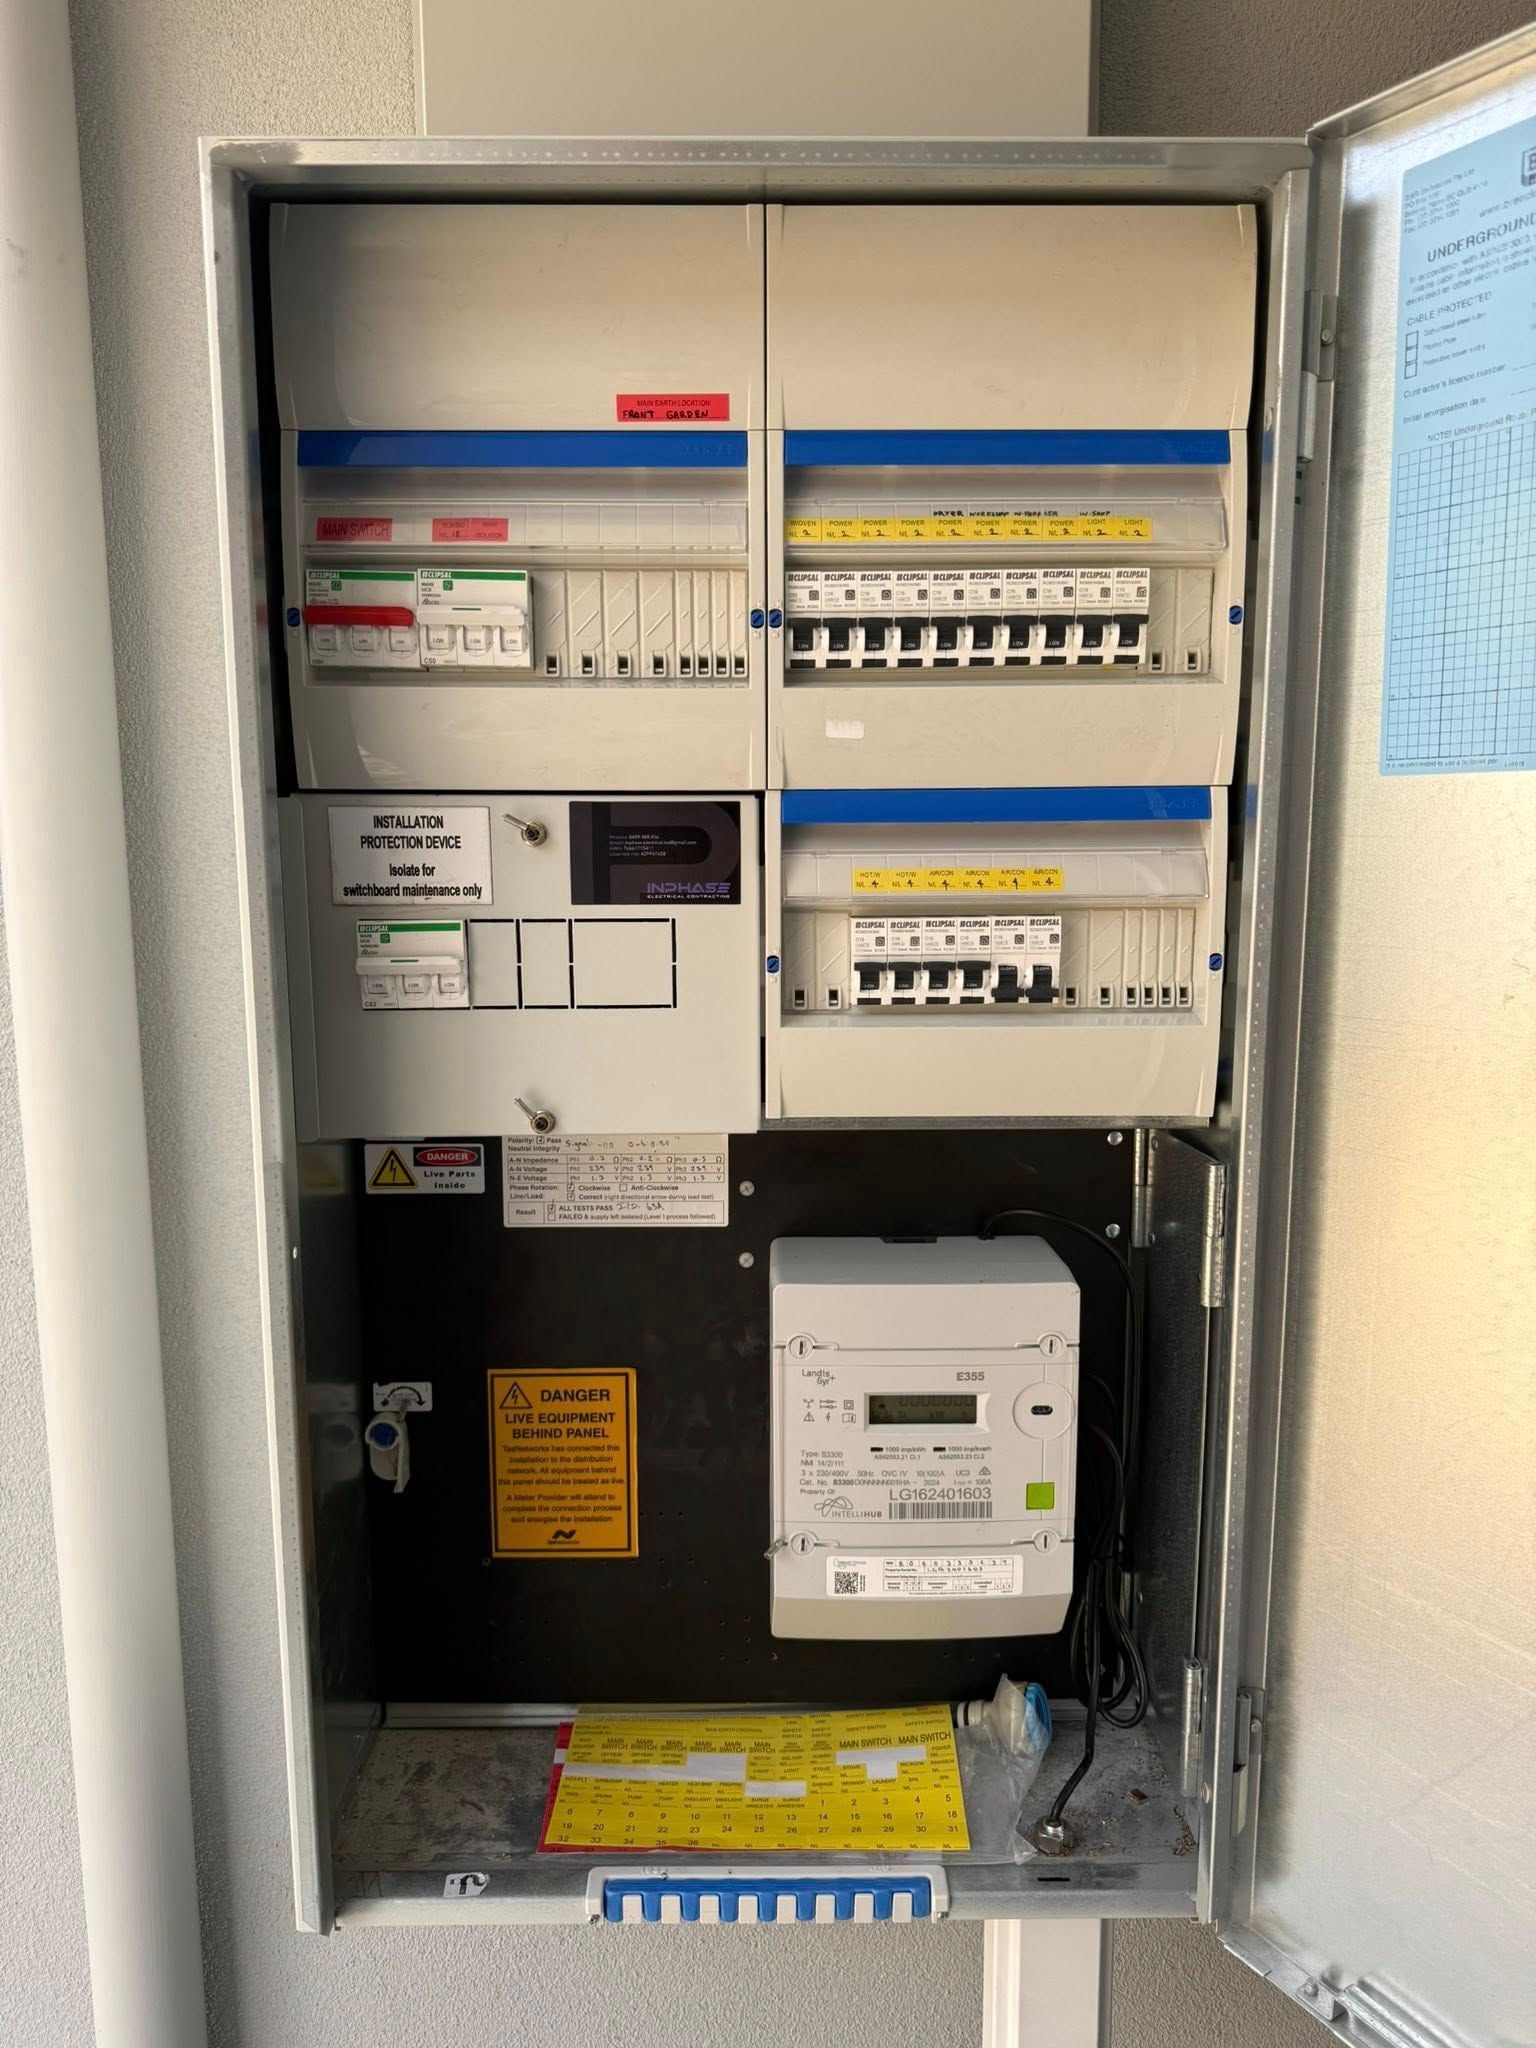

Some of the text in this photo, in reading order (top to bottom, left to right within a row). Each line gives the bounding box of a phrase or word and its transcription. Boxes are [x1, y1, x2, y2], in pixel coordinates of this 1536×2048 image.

[1407, 310, 1435, 326] CABLE
[678, 399, 712, 407] LOCATION
[623, 409, 709, 420] FRONT GARDEN
[1087, 518, 1106, 526] LIGHT
[322, 523, 389, 537] MAIN SWITCH
[793, 573, 819, 582] CLIPSAL
[830, 573, 856, 581] CLIPSAL
[866, 573, 892, 581] CLIPSAL
[902, 573, 928, 581] CLIPSAL
[938, 573, 964, 581] CLIPSAL
[975, 572, 1001, 580] CLIPSAL
[1012, 572, 1037, 580] CLIPSAL
[1048, 570, 1074, 578] CLIPSAL
[1085, 571, 1112, 579] CLIPSAL
[1122, 570, 1148, 579] CLIPSAL
[373, 815, 444, 829] INSTALLATION
[360, 836, 462, 849] PROTECTION DEVICE
[389, 863, 436, 877] Isolate for
[929, 869, 954, 877] AIR/CON
[965, 869, 990, 877] AIR/CON
[1000, 868, 1026, 876] AIR/CON
[860, 871, 881, 879] HOT/W
[343, 883, 483, 900] switchboard maintenance only
[647, 882, 731, 894] INPHASE
[862, 921, 886, 929] CLIPSAL
[897, 921, 921, 929] CLIPSAL
[932, 919, 956, 928] CLIPSAL
[966, 920, 990, 928] CLIPSAL
[1000, 918, 1025, 926] CLIPSAL
[1035, 918, 1060, 926] CLIPSAL
[427, 1153, 470, 1161] DANGER
[523, 1157, 559, 1165] Impedance
[956, 1372, 985, 1382] E355
[541, 1389, 611, 1403] DANGER
[505, 1412, 616, 1424] LIVE EQUIPMENT
[512, 1428, 609, 1439] BEHIND PANEL
[801, 1451, 820, 1459] Type:
[800, 1488, 825, 1496] Property
[889, 1487, 992, 1501] LG162401603
[831, 1510, 882, 1518] INTELLIHUB
[898, 1731, 952, 1745] MAIN SWITCH
[839, 1737, 892, 1749] MAIN SWITCH
[914, 1796, 921, 1804] 4
[945, 1794, 951, 1802] 5
[567, 1808, 573, 1816] 6
[593, 1823, 604, 1831] 20
[689, 1826, 700, 1834] 23
[722, 1825, 733, 1833] 24
